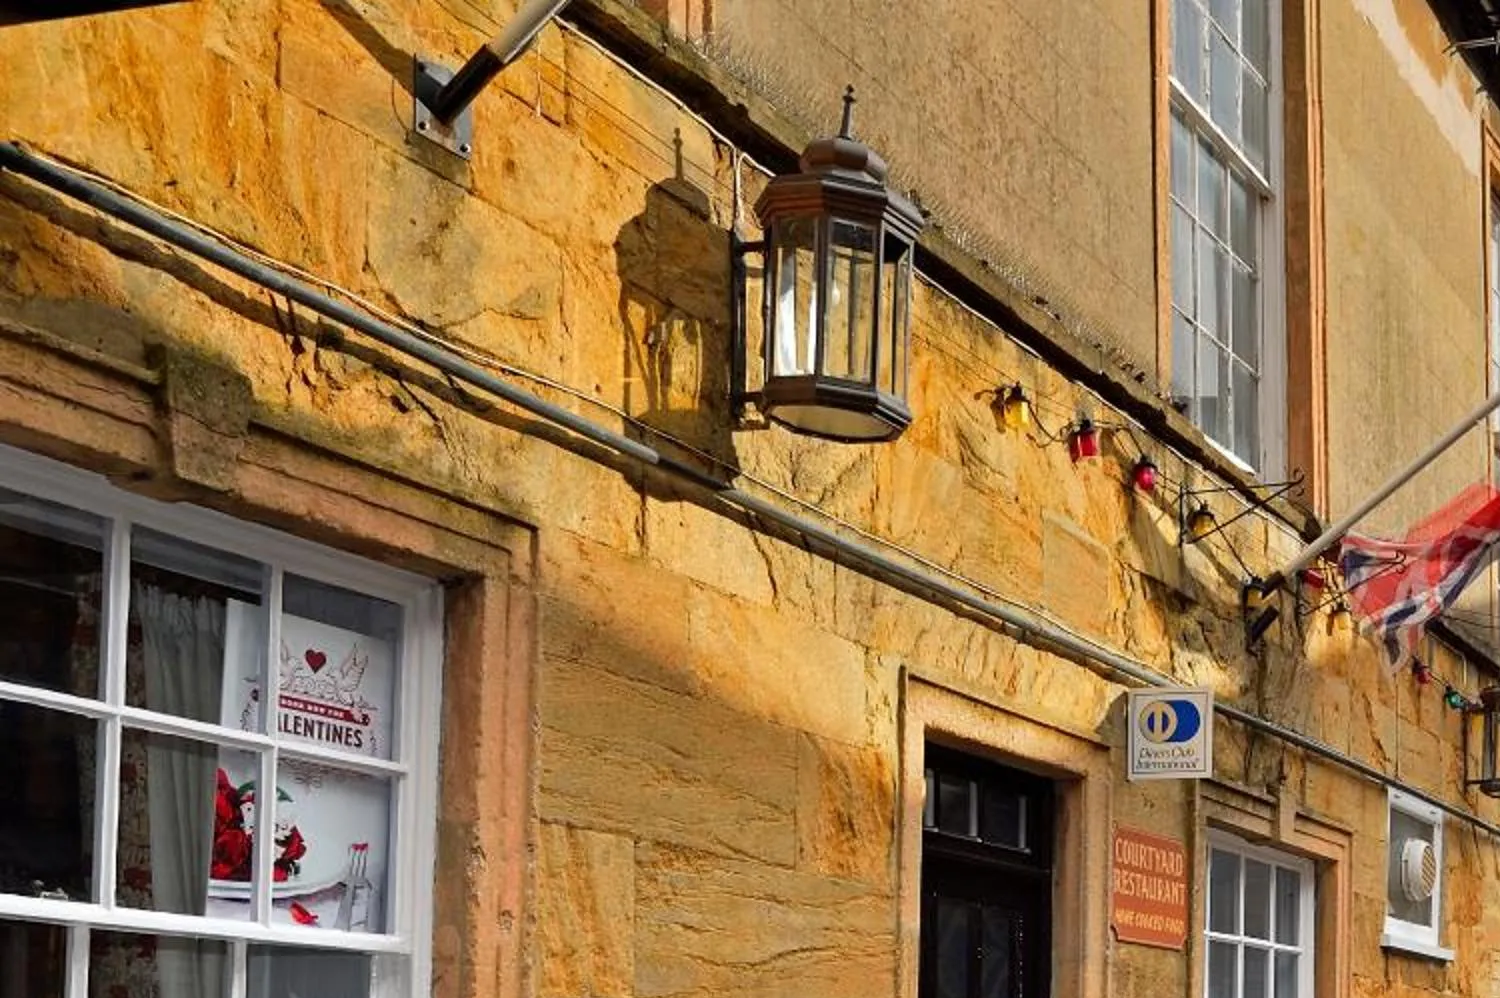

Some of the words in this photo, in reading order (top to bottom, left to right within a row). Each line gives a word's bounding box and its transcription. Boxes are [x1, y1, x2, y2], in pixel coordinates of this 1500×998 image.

[278, 713, 362, 747] LENTINES
[1115, 837, 1184, 877] COURTYARD
[1113, 867, 1186, 905] RESTAURANT
